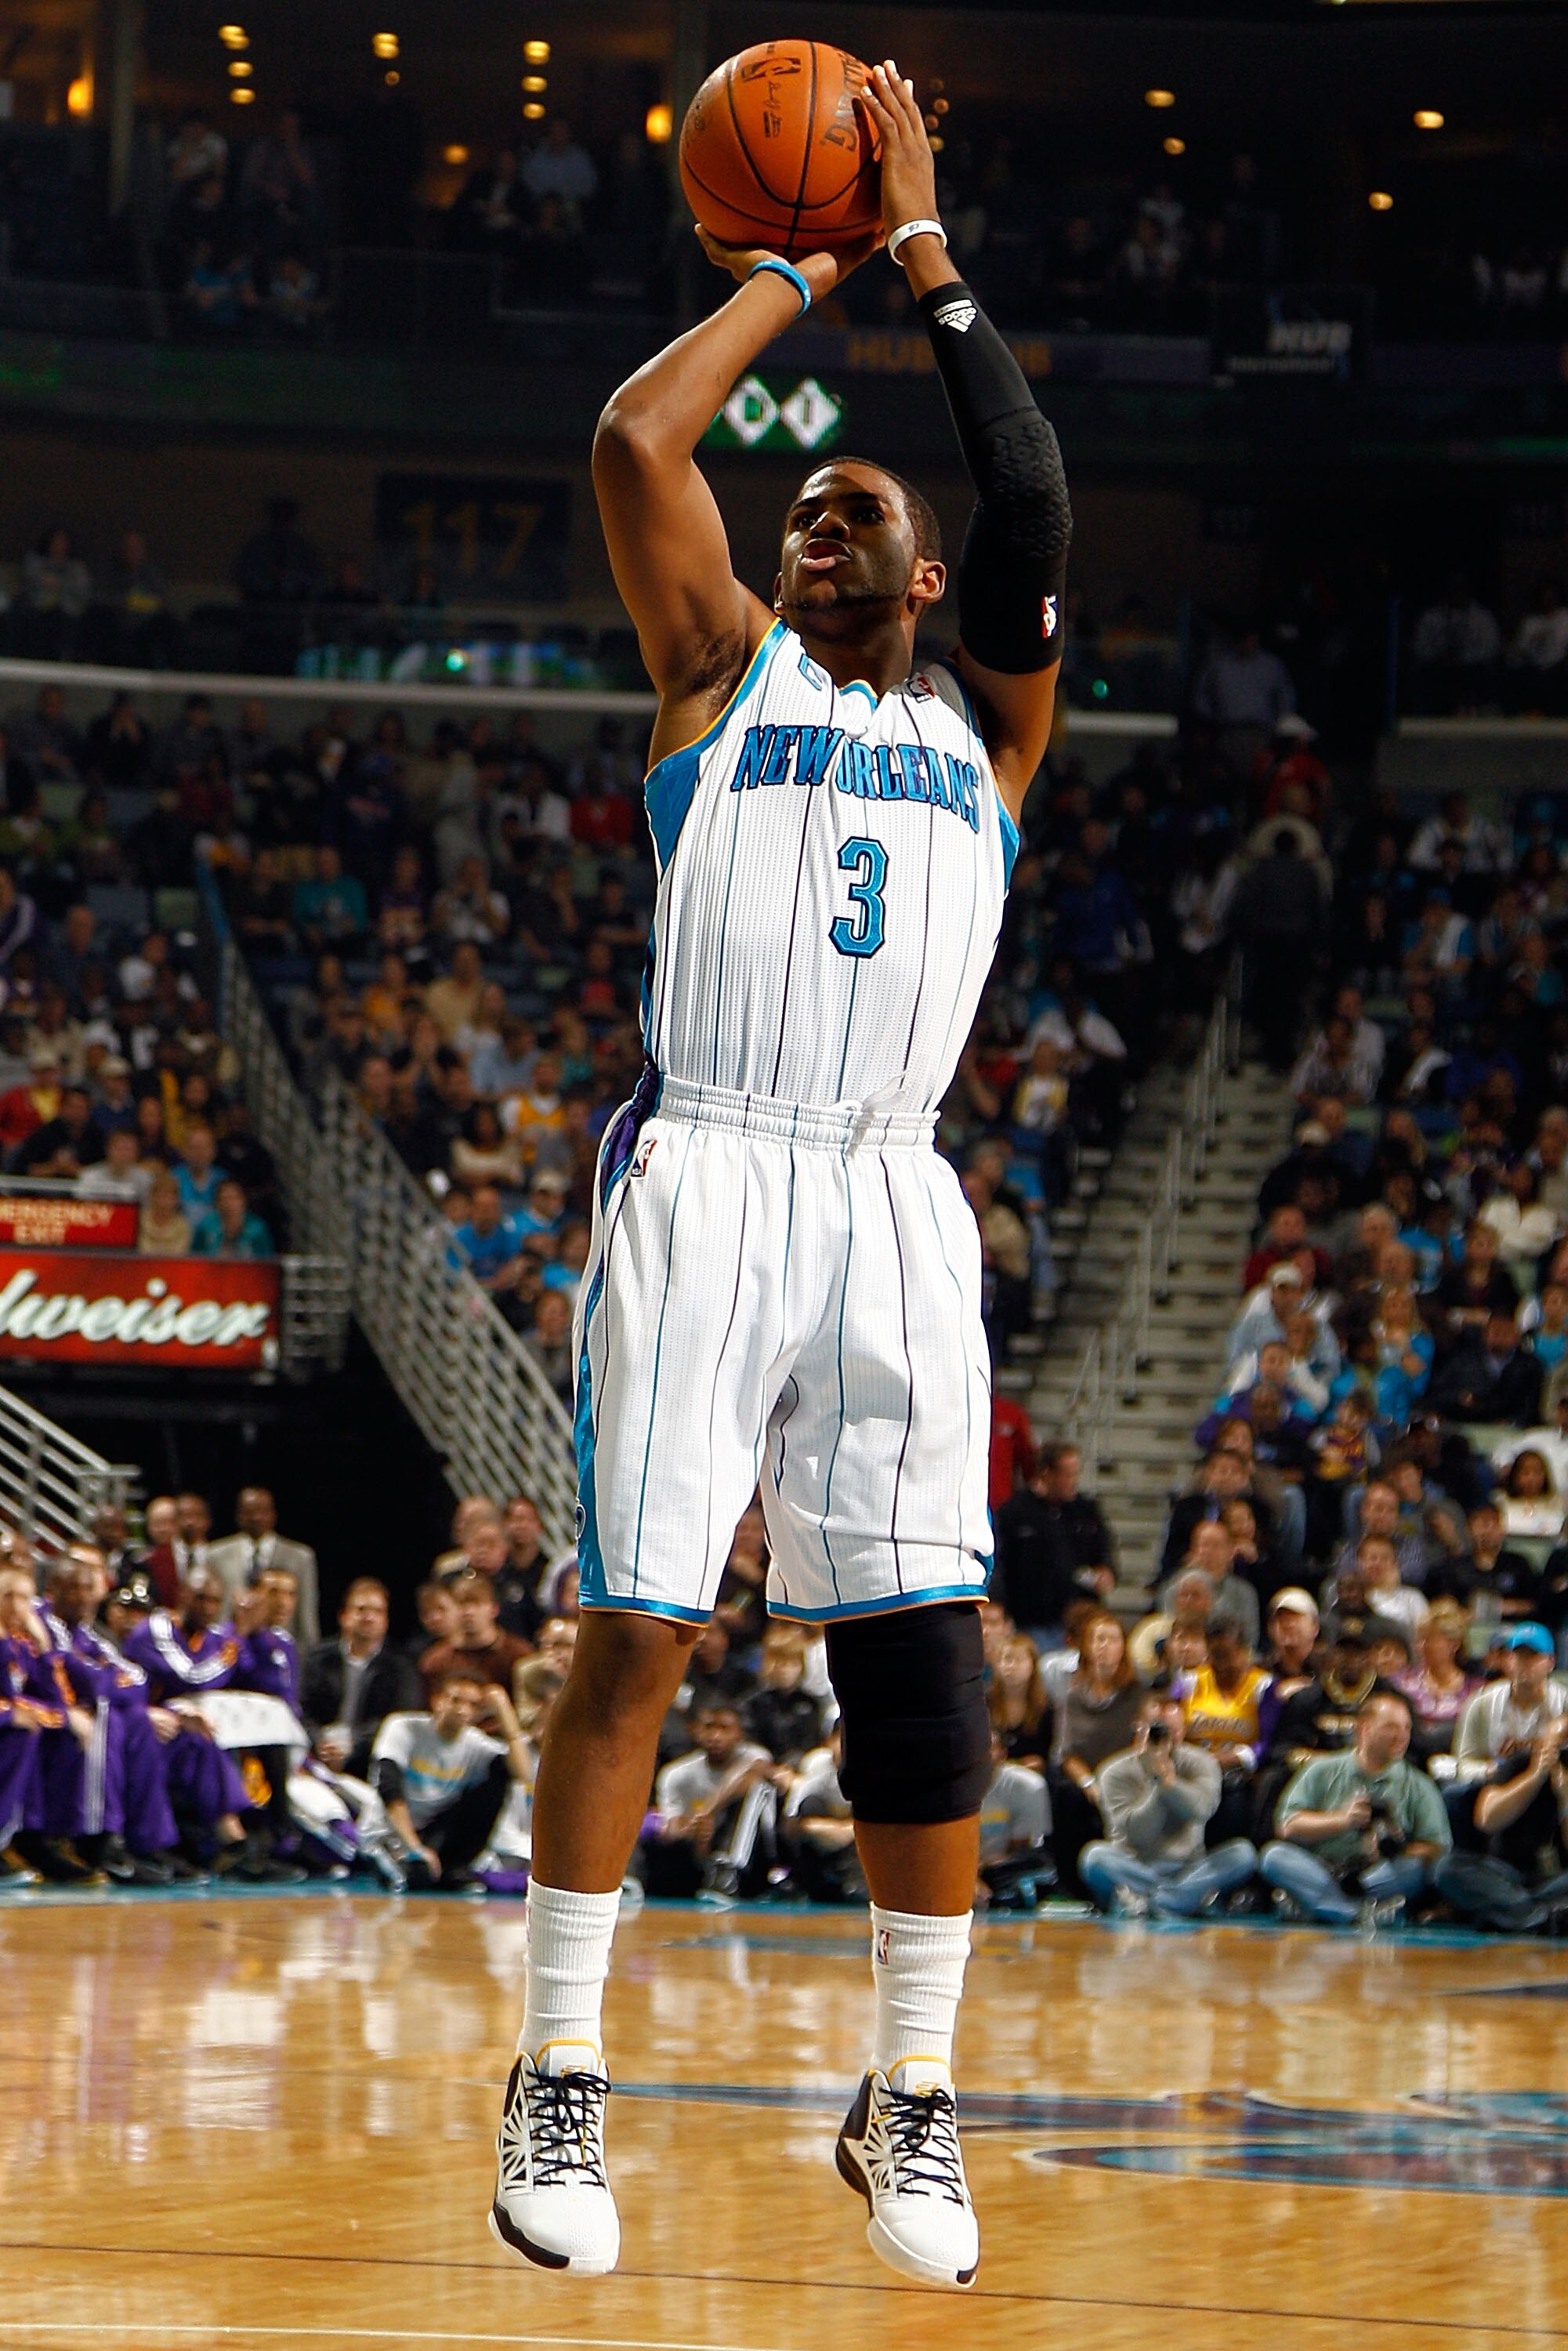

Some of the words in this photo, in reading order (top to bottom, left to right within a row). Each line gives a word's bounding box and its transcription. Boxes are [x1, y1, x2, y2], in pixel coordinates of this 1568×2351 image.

[938, 306, 977, 326] adidas
[401, 501, 543, 576] 117
[730, 723, 846, 792] NEW
[835, 738, 980, 834] ORLEANS
[828, 836, 889, 958] 3
